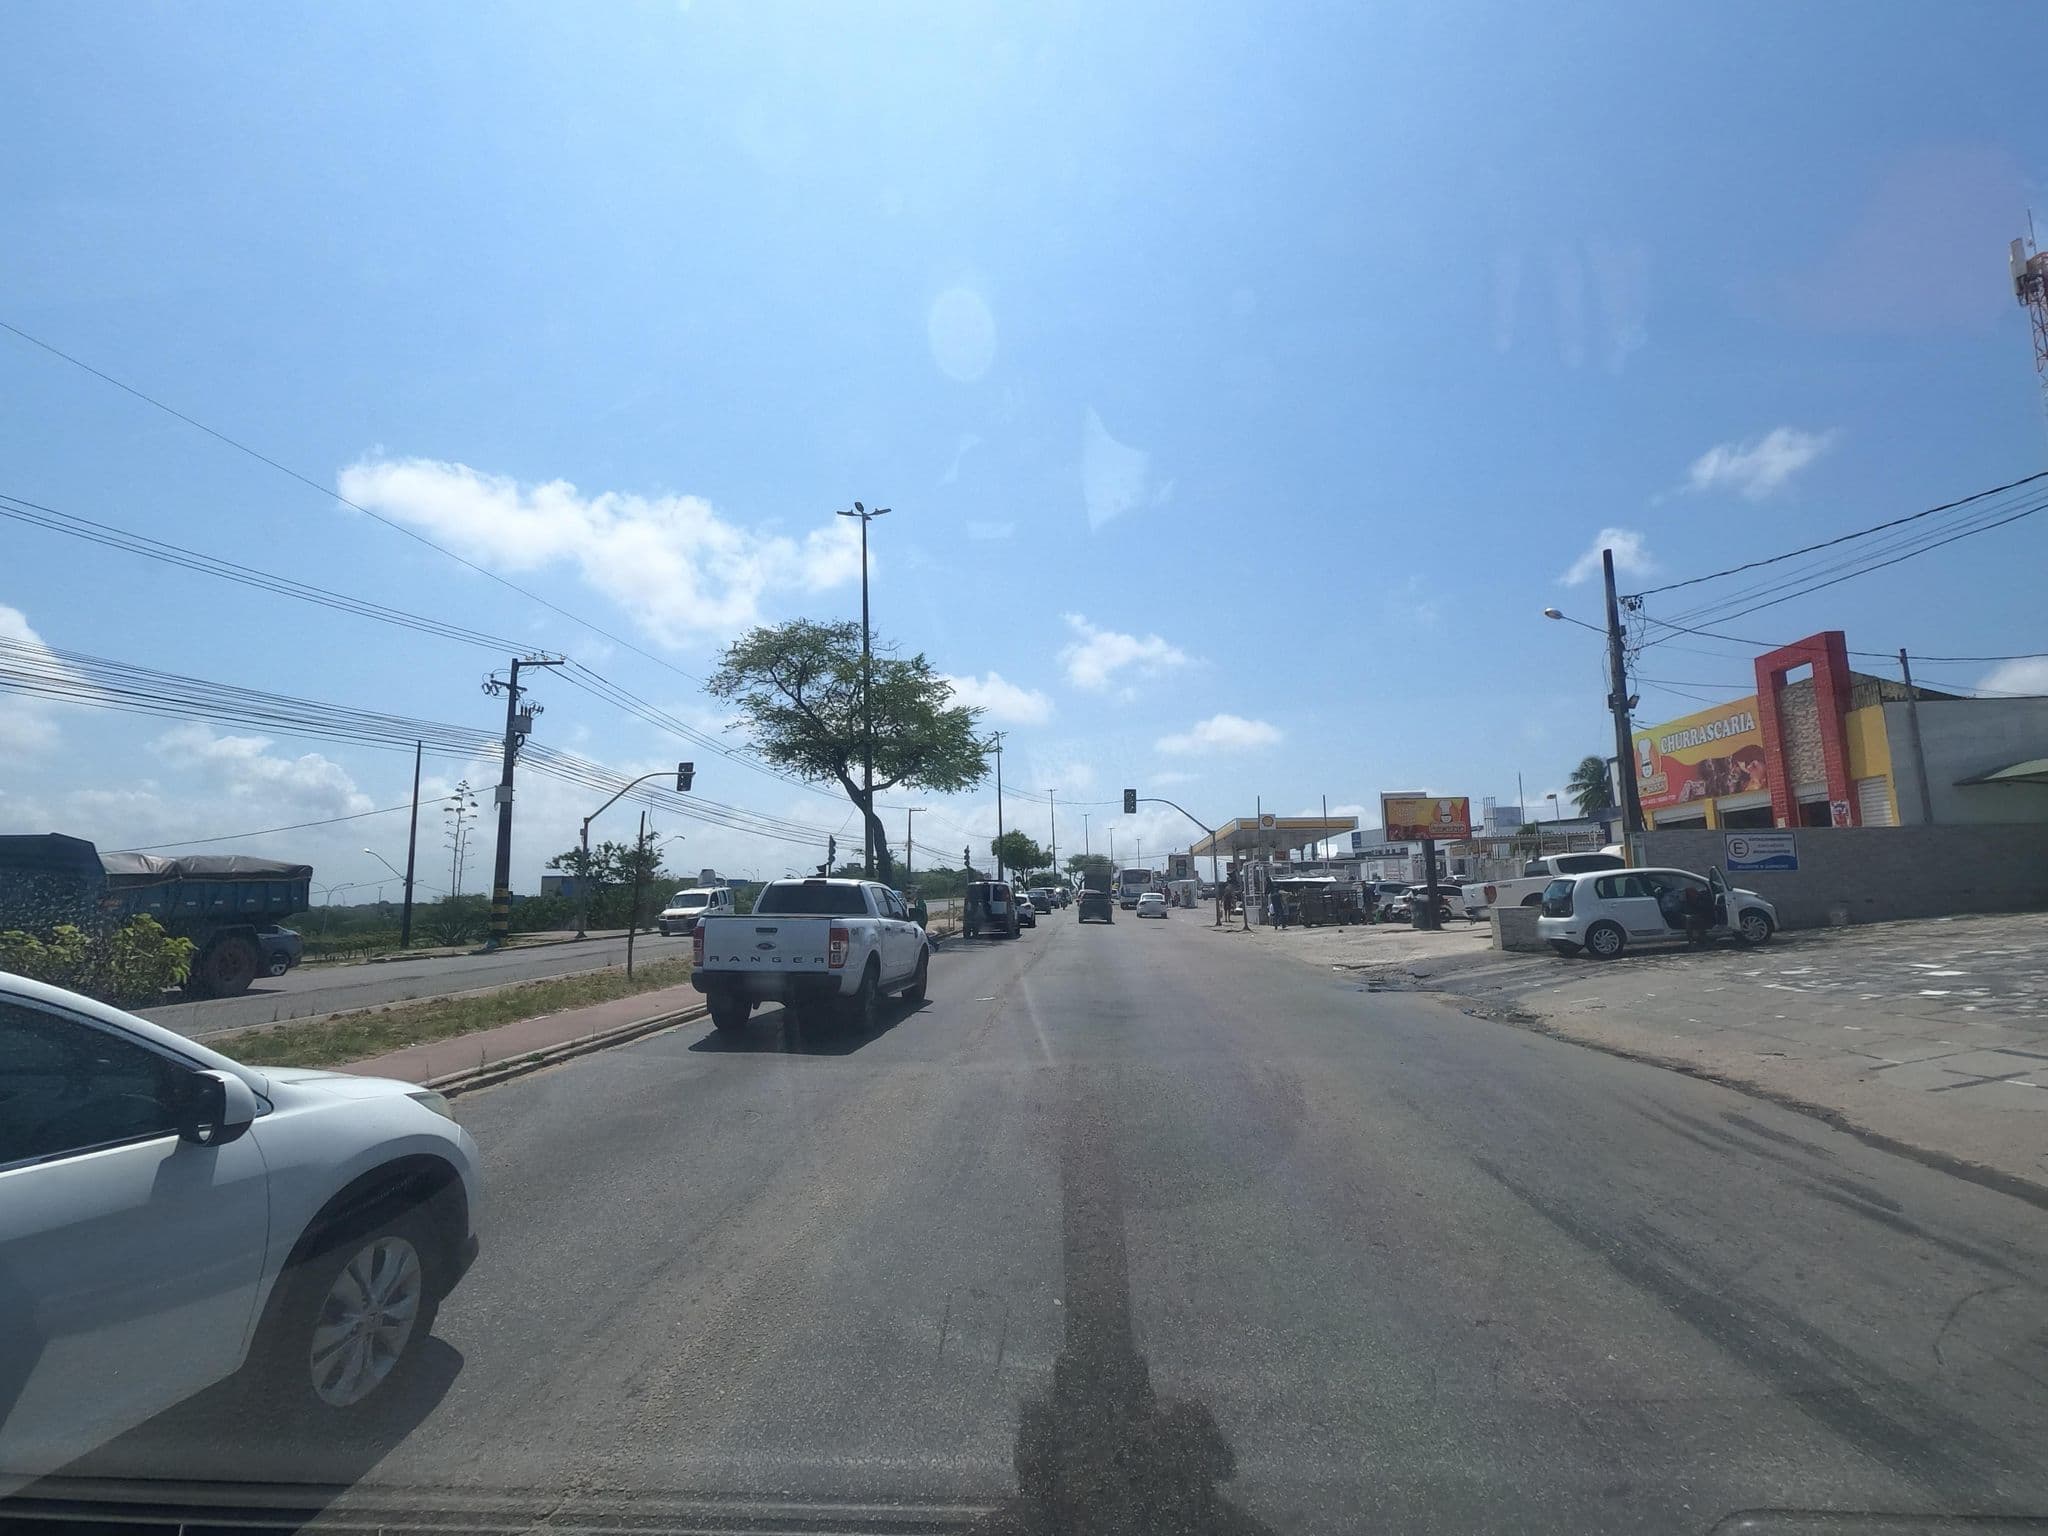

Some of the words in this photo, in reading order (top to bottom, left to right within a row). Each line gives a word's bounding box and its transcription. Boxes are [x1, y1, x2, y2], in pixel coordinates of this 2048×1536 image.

[1660, 711, 1756, 754] CHURRASCARIA
[1733, 842, 1745, 855] E
[709, 955, 825, 964] RANGER
